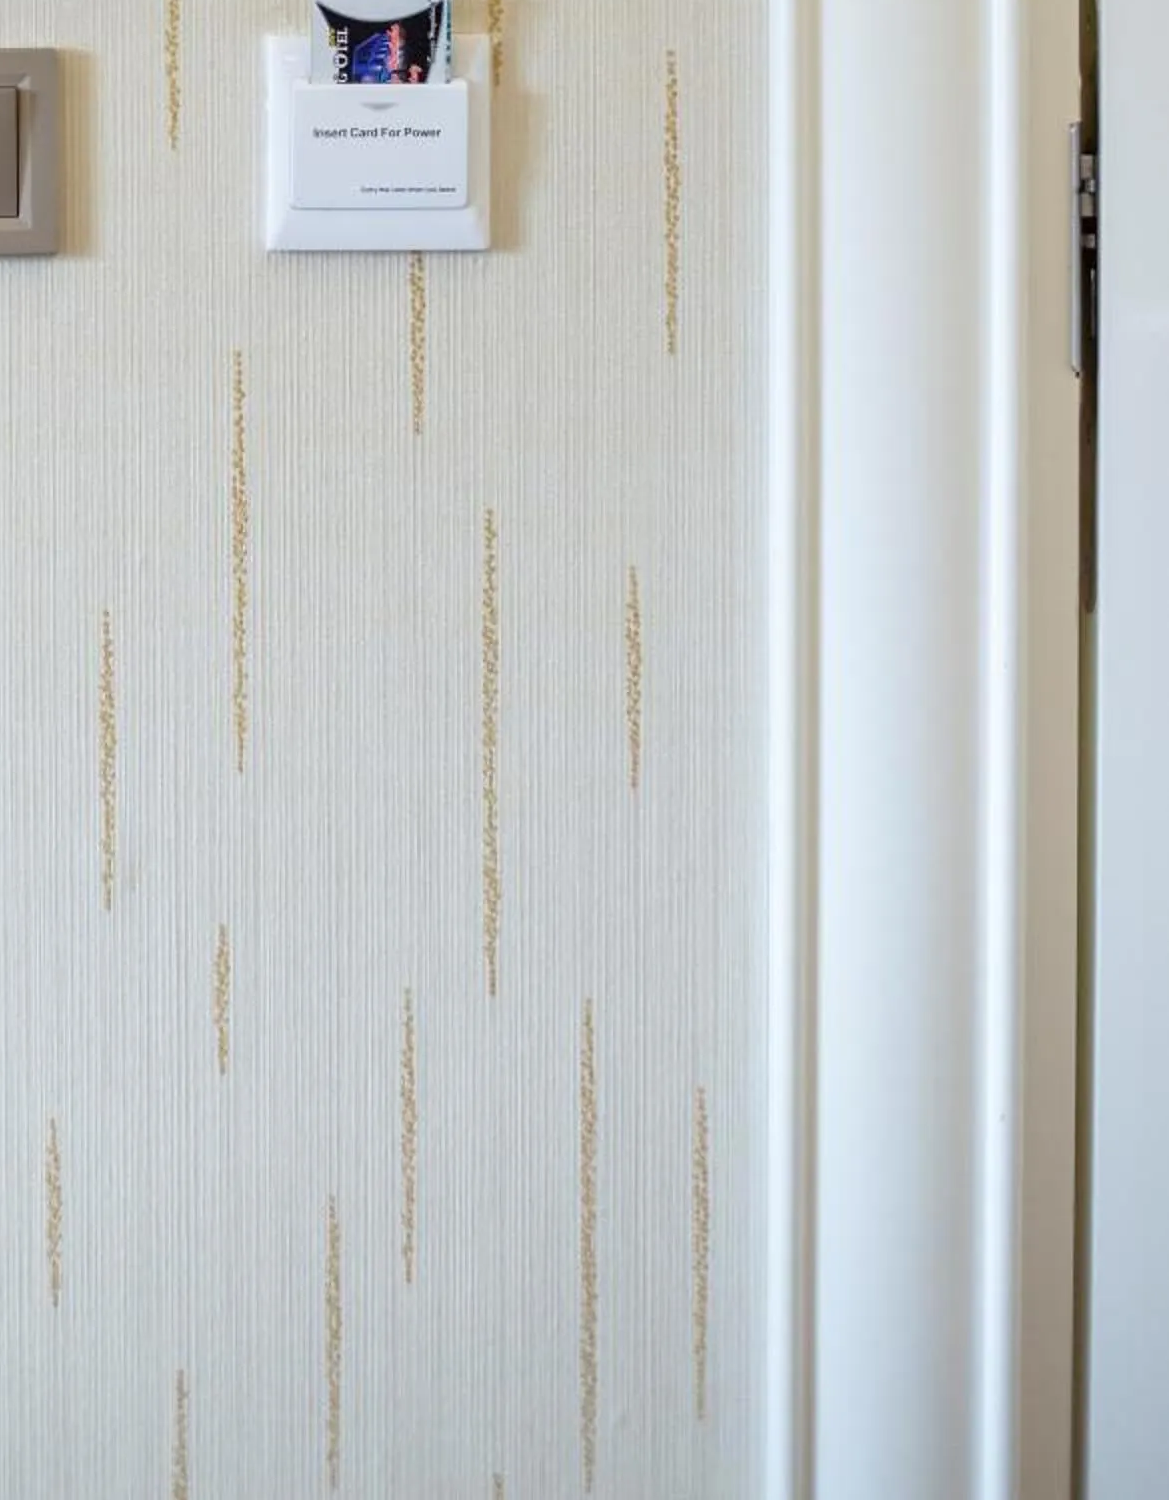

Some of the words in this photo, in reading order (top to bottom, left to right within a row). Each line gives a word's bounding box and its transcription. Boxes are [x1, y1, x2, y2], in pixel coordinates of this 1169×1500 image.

[312, 126, 348, 139] Insert
[350, 126, 378, 138] Card
[380, 126, 402, 138] For
[403, 125, 442, 138] Power
